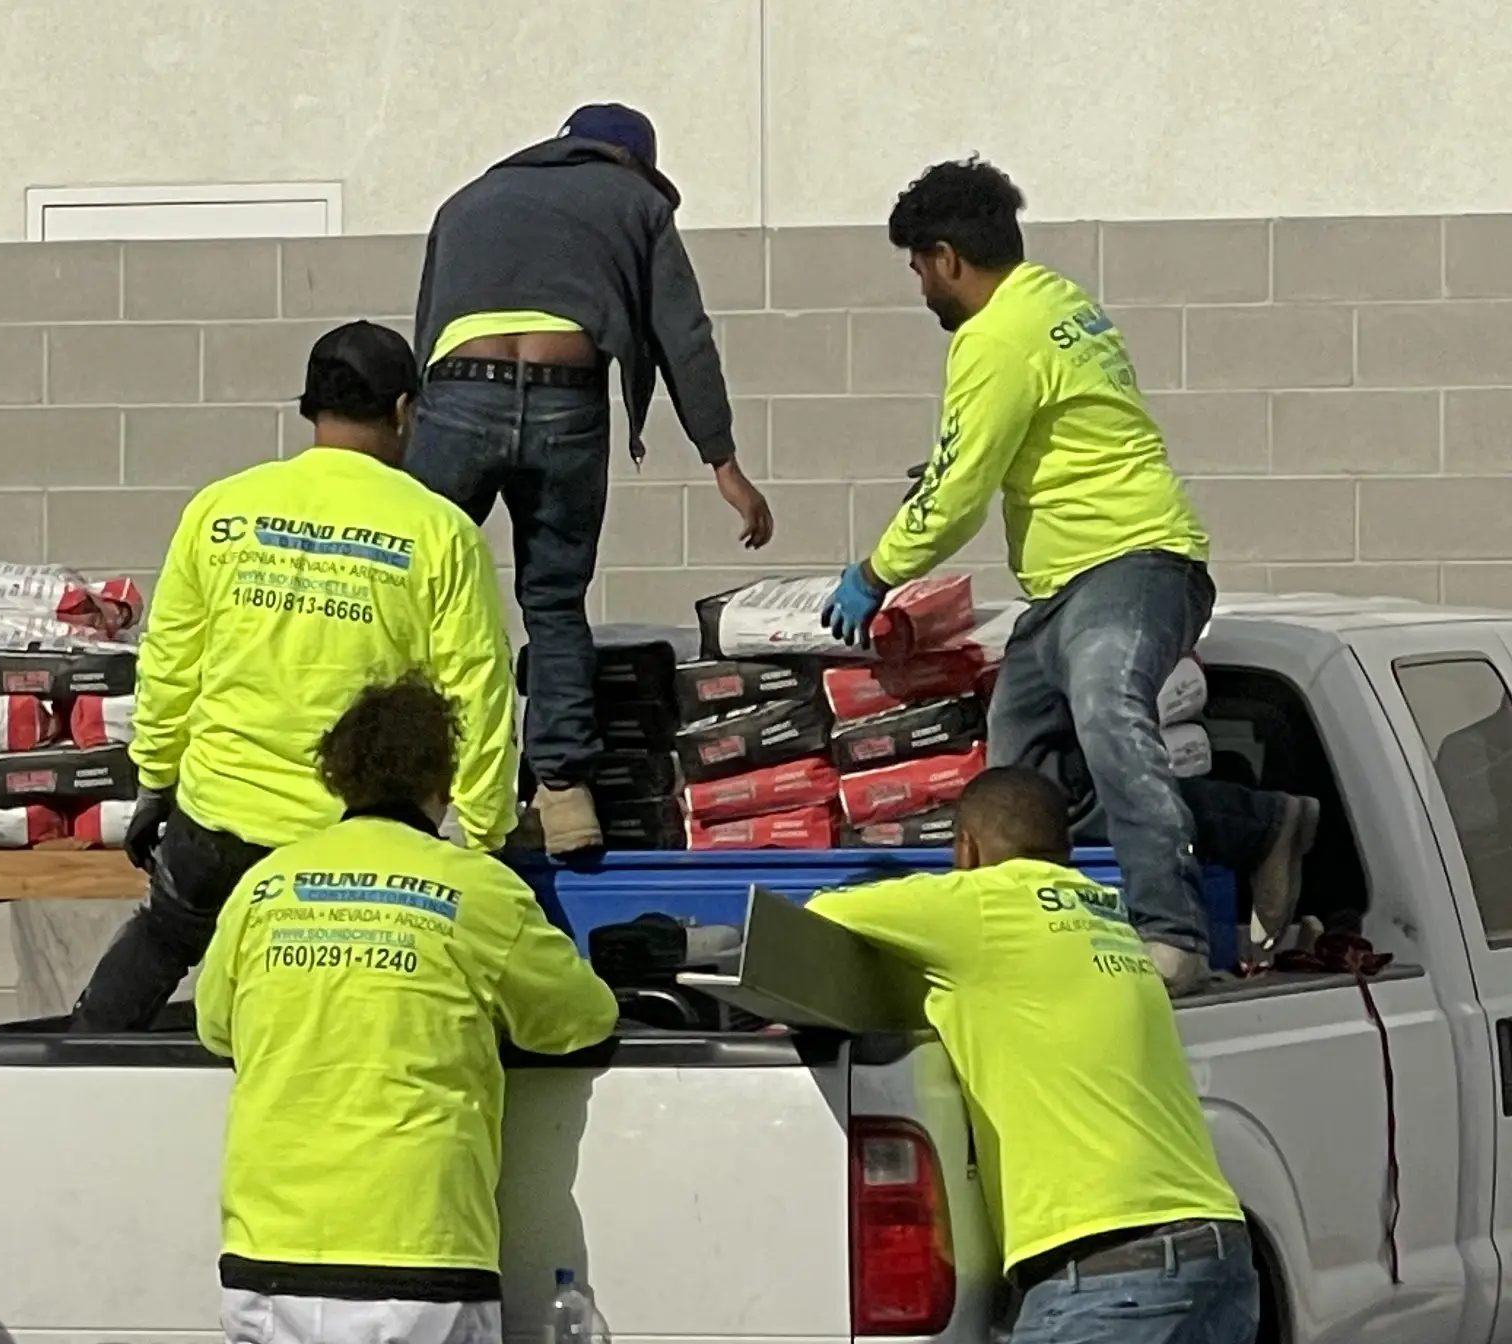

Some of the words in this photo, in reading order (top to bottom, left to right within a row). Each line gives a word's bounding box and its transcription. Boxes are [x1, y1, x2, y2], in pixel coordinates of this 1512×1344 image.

[210, 516, 248, 544] SC
[255, 516, 335, 540] SOUND
[341, 526, 415, 553] CRETE
[349, 564, 407, 589] ARIZONA
[250, 874, 285, 904] SC
[294, 872, 378, 887] SOUND
[386, 874, 463, 904] CRETE
[328, 908, 381, 922] NEVADA
[394, 911, 454, 938] ARIZONA
[265, 945, 417, 973] (760)291-1240
